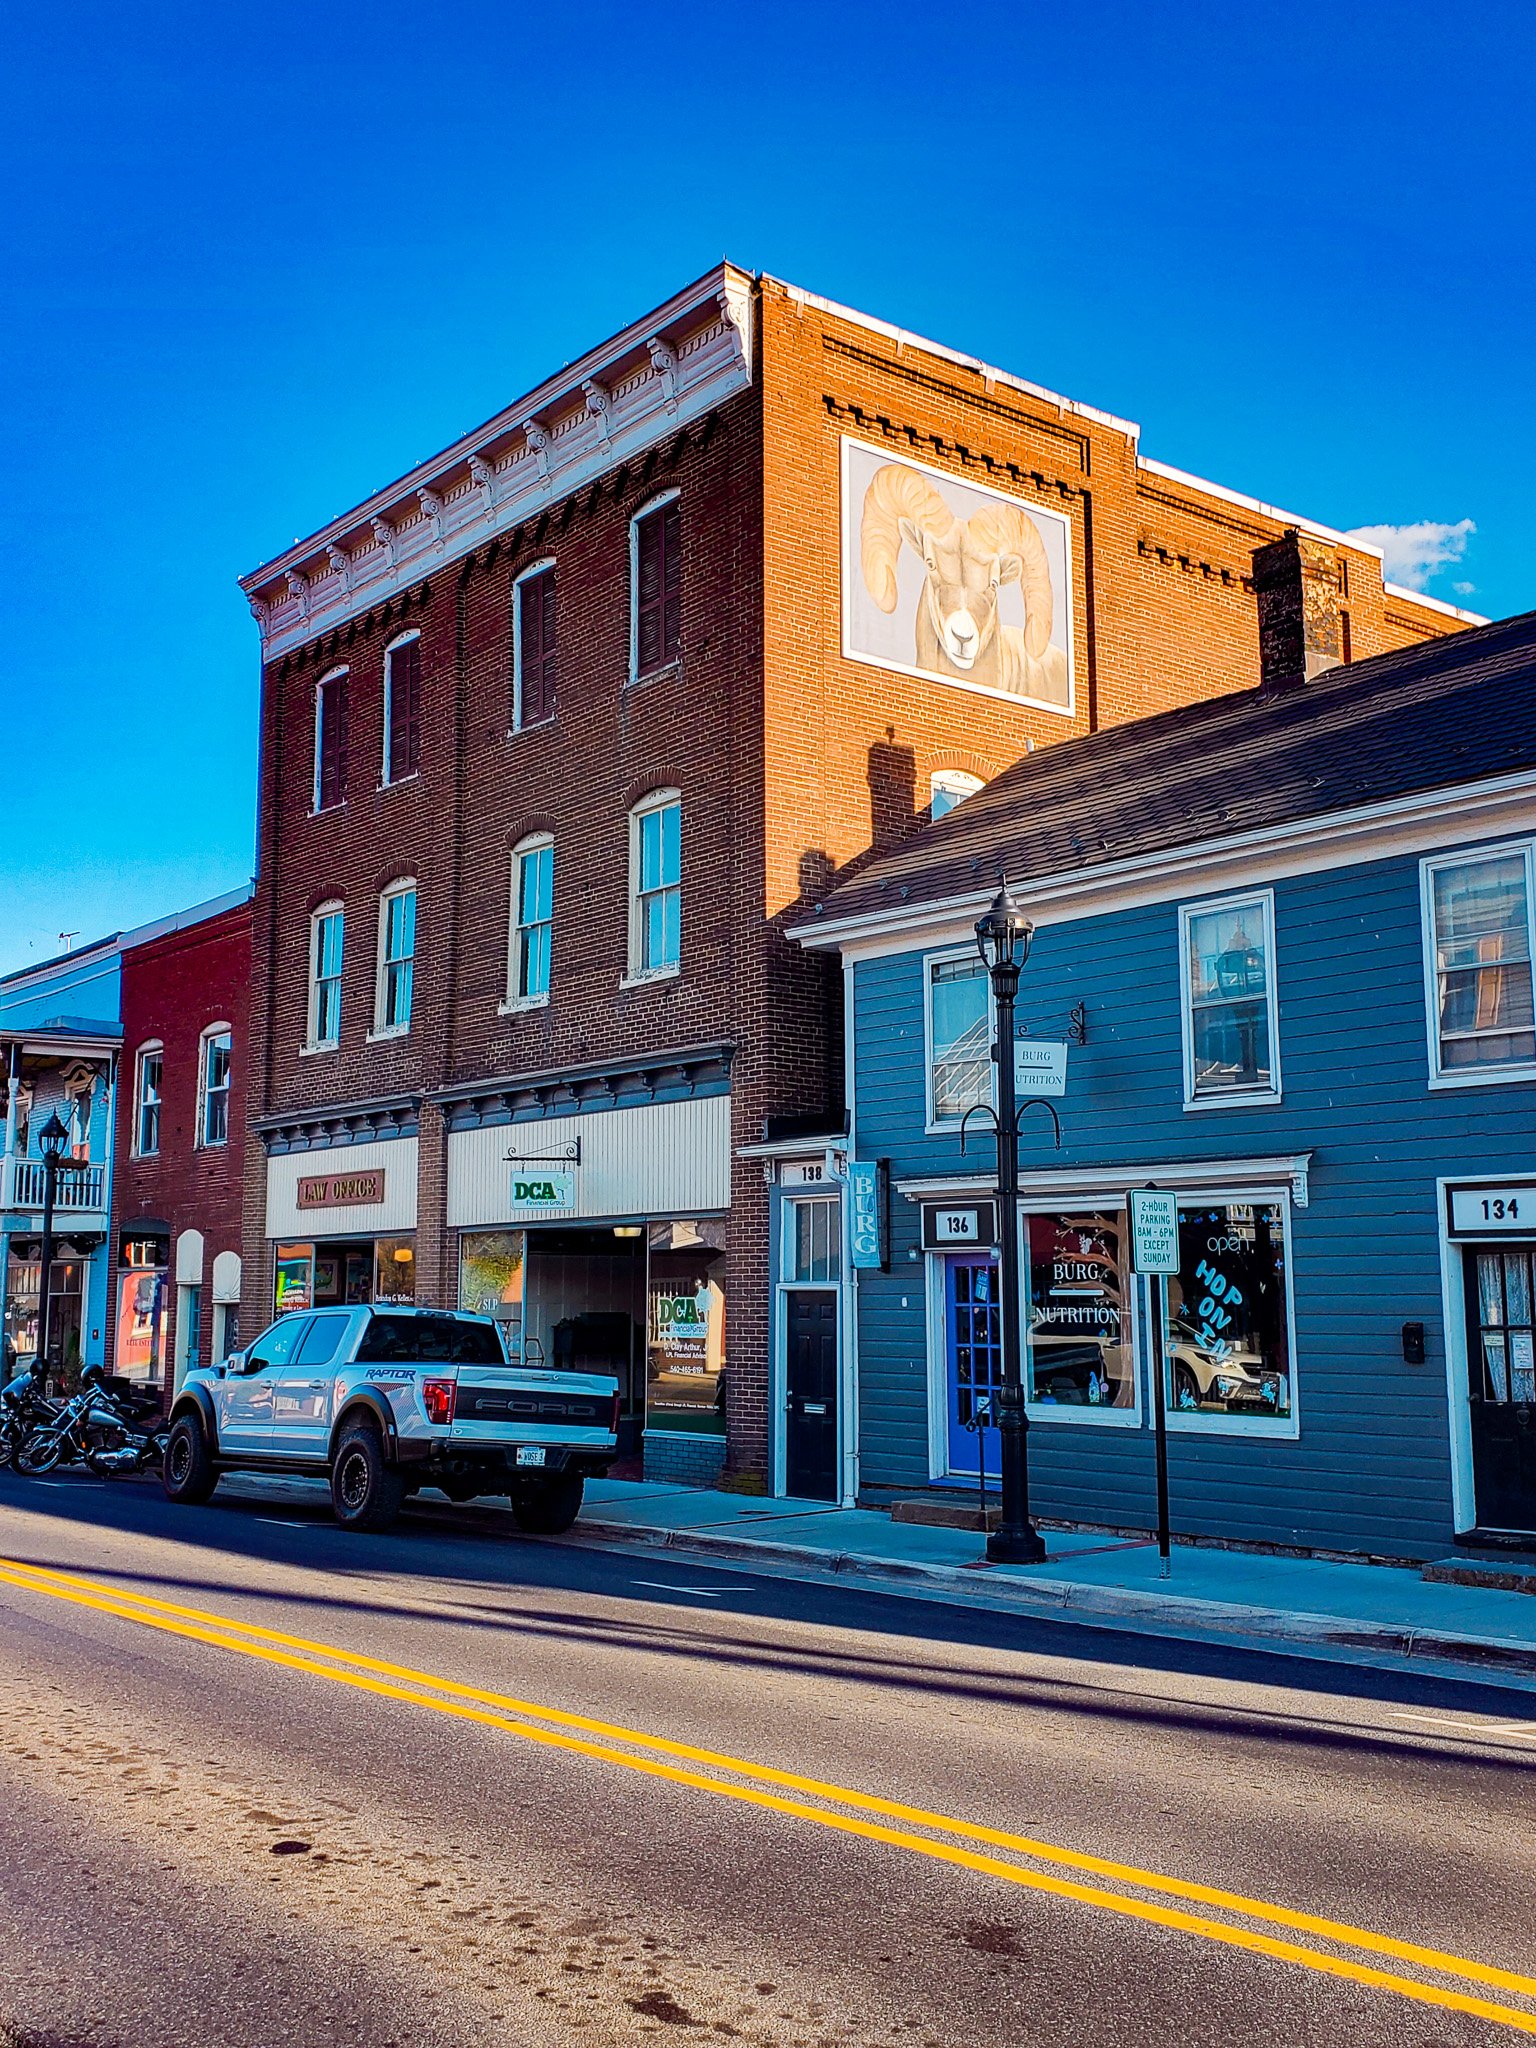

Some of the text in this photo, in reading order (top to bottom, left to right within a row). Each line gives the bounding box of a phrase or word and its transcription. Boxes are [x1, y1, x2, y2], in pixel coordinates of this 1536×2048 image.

[1022, 1051, 1051, 1061] BURG
[1015, 1075, 1063, 1085] UTRITION
[802, 1166, 822, 1181] 138
[303, 1177, 377, 1202] LAW OFFICE
[514, 1182, 557, 1200] DCA
[1141, 1200, 1168, 1212] 2-HOUR
[1481, 1198, 1519, 1220] 134
[854, 1176, 877, 1254] BURG
[1140, 1214, 1171, 1225] PARKING
[947, 1216, 969, 1233] 136
[1137, 1226, 1152, 1237] 8AM
[1159, 1227, 1174, 1238] 6PM
[1143, 1240, 1170, 1250] EXCEPT
[1207, 1236, 1250, 1256] open
[1143, 1253, 1171, 1264] SUNDAY
[1053, 1263, 1099, 1280] BURG
[1195, 1259, 1243, 1305] HOP
[482, 1298, 498, 1311] SLP
[659, 1298, 700, 1324] DCA
[1198, 1296, 1232, 1330] ON
[1035, 1307, 1121, 1324] NUTRITION
[1194, 1321, 1233, 1362] IN
[365, 1369, 417, 1383] RAPTOR
[475, 1398, 596, 1417] FORD
